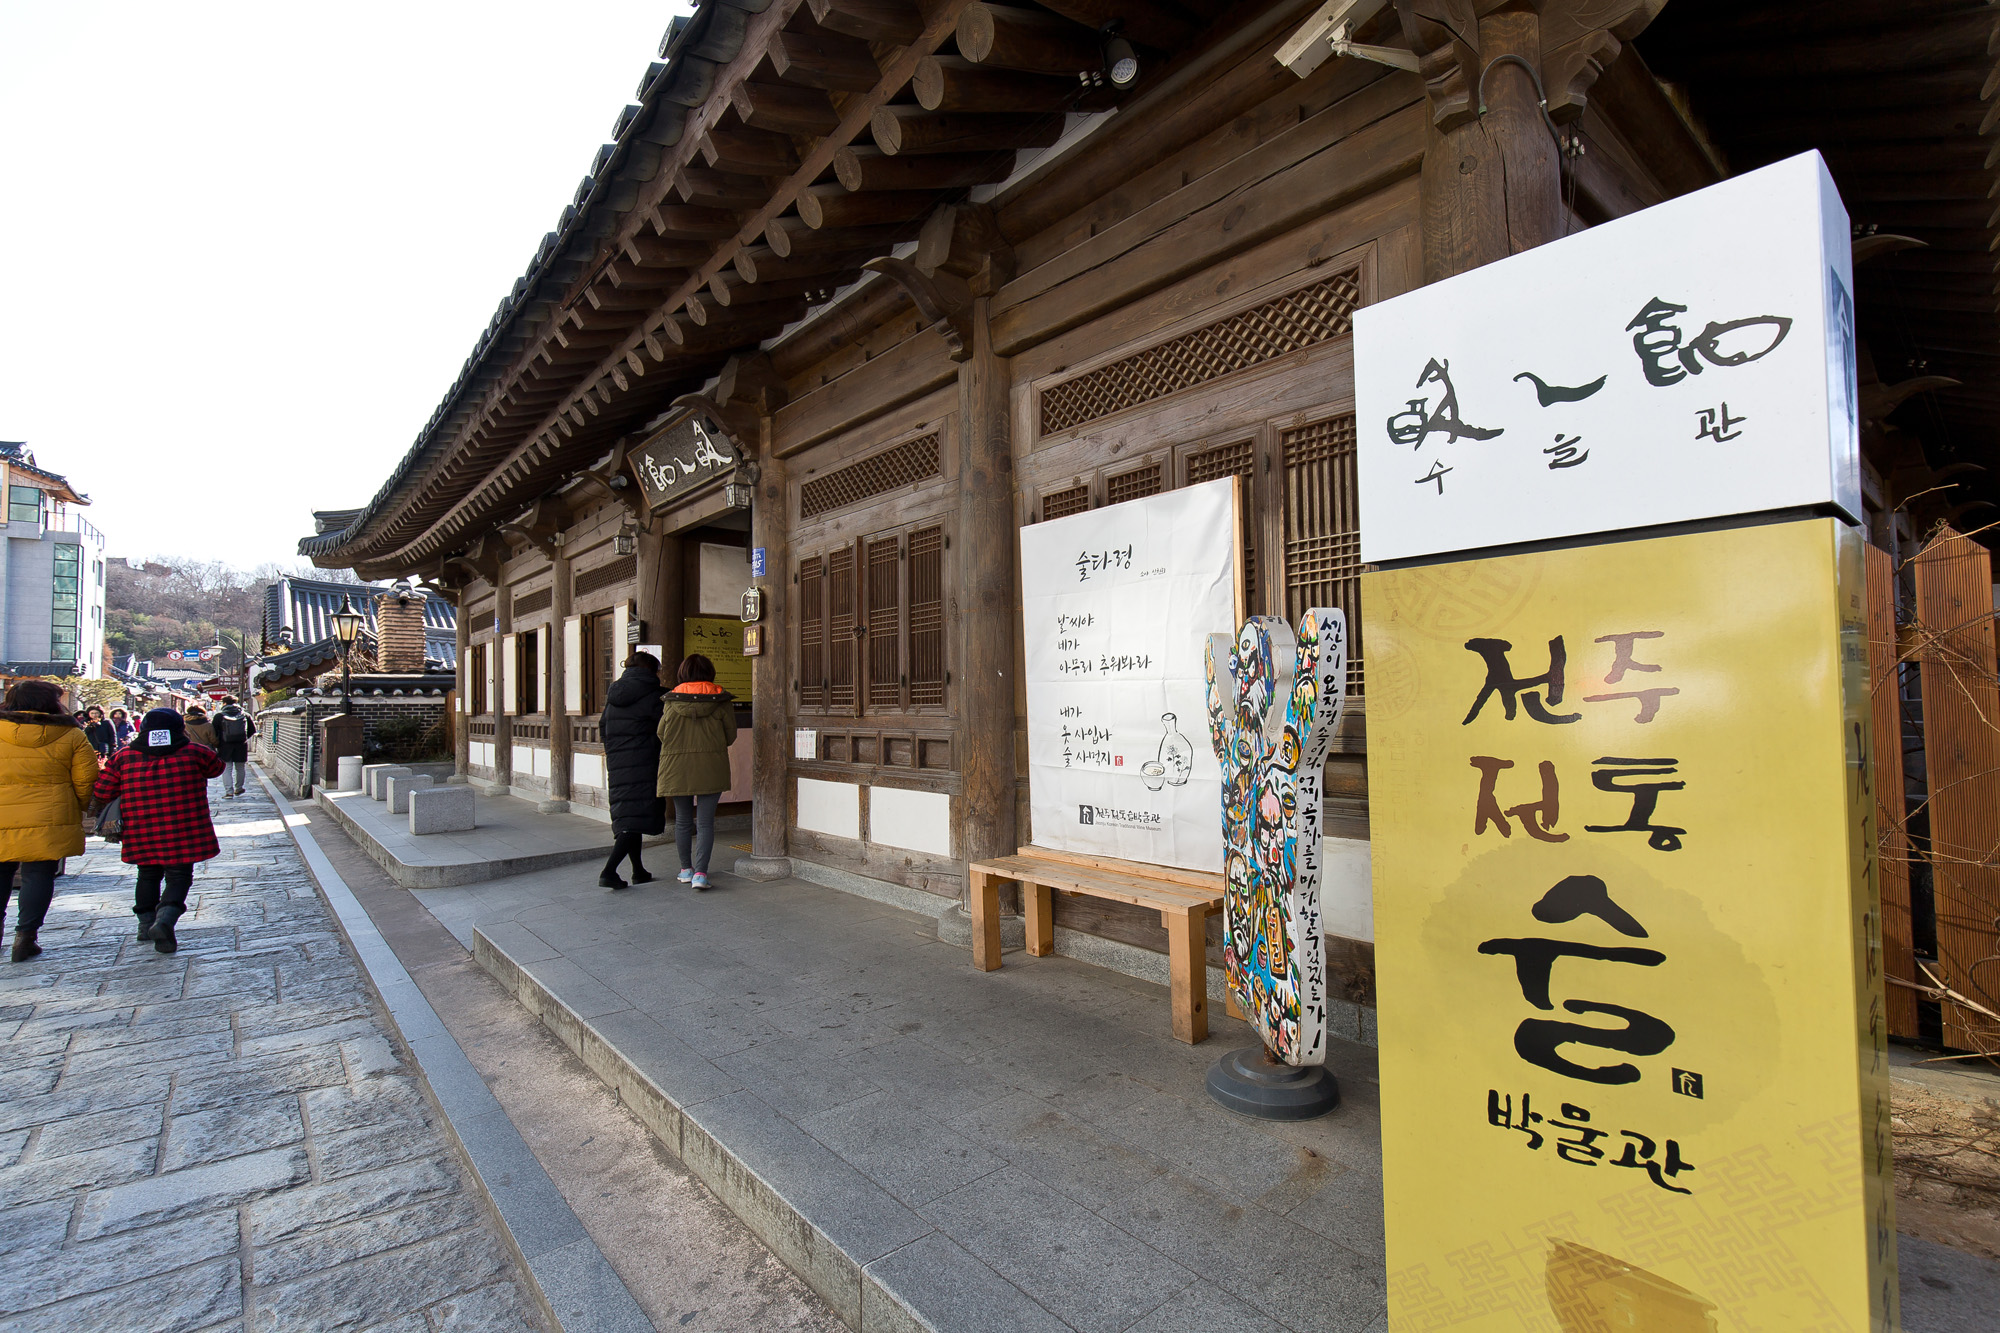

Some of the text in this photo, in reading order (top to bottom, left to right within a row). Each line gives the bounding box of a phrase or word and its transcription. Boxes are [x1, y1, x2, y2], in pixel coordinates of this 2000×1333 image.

[1075, 543, 1133, 582] 술타령
[745, 603, 756, 616] 74
[1057, 612, 1095, 634] 날씨야
[1057, 638, 1081, 651] 네가
[1059, 653, 1153, 676] 아무리 추워봐라
[1461, 630, 1681, 726] 전주
[1060, 705, 1083, 718] 내가
[1061, 724, 1113, 745] 옷 사입나
[1062, 746, 1111, 768] 술 사먹지
[1298, 774, 1320, 801] 어찌
[1469, 755, 1688, 853] 전통
[1477, 874, 1676, 1086] 술
[1487, 1088, 1696, 1196] 박물관
